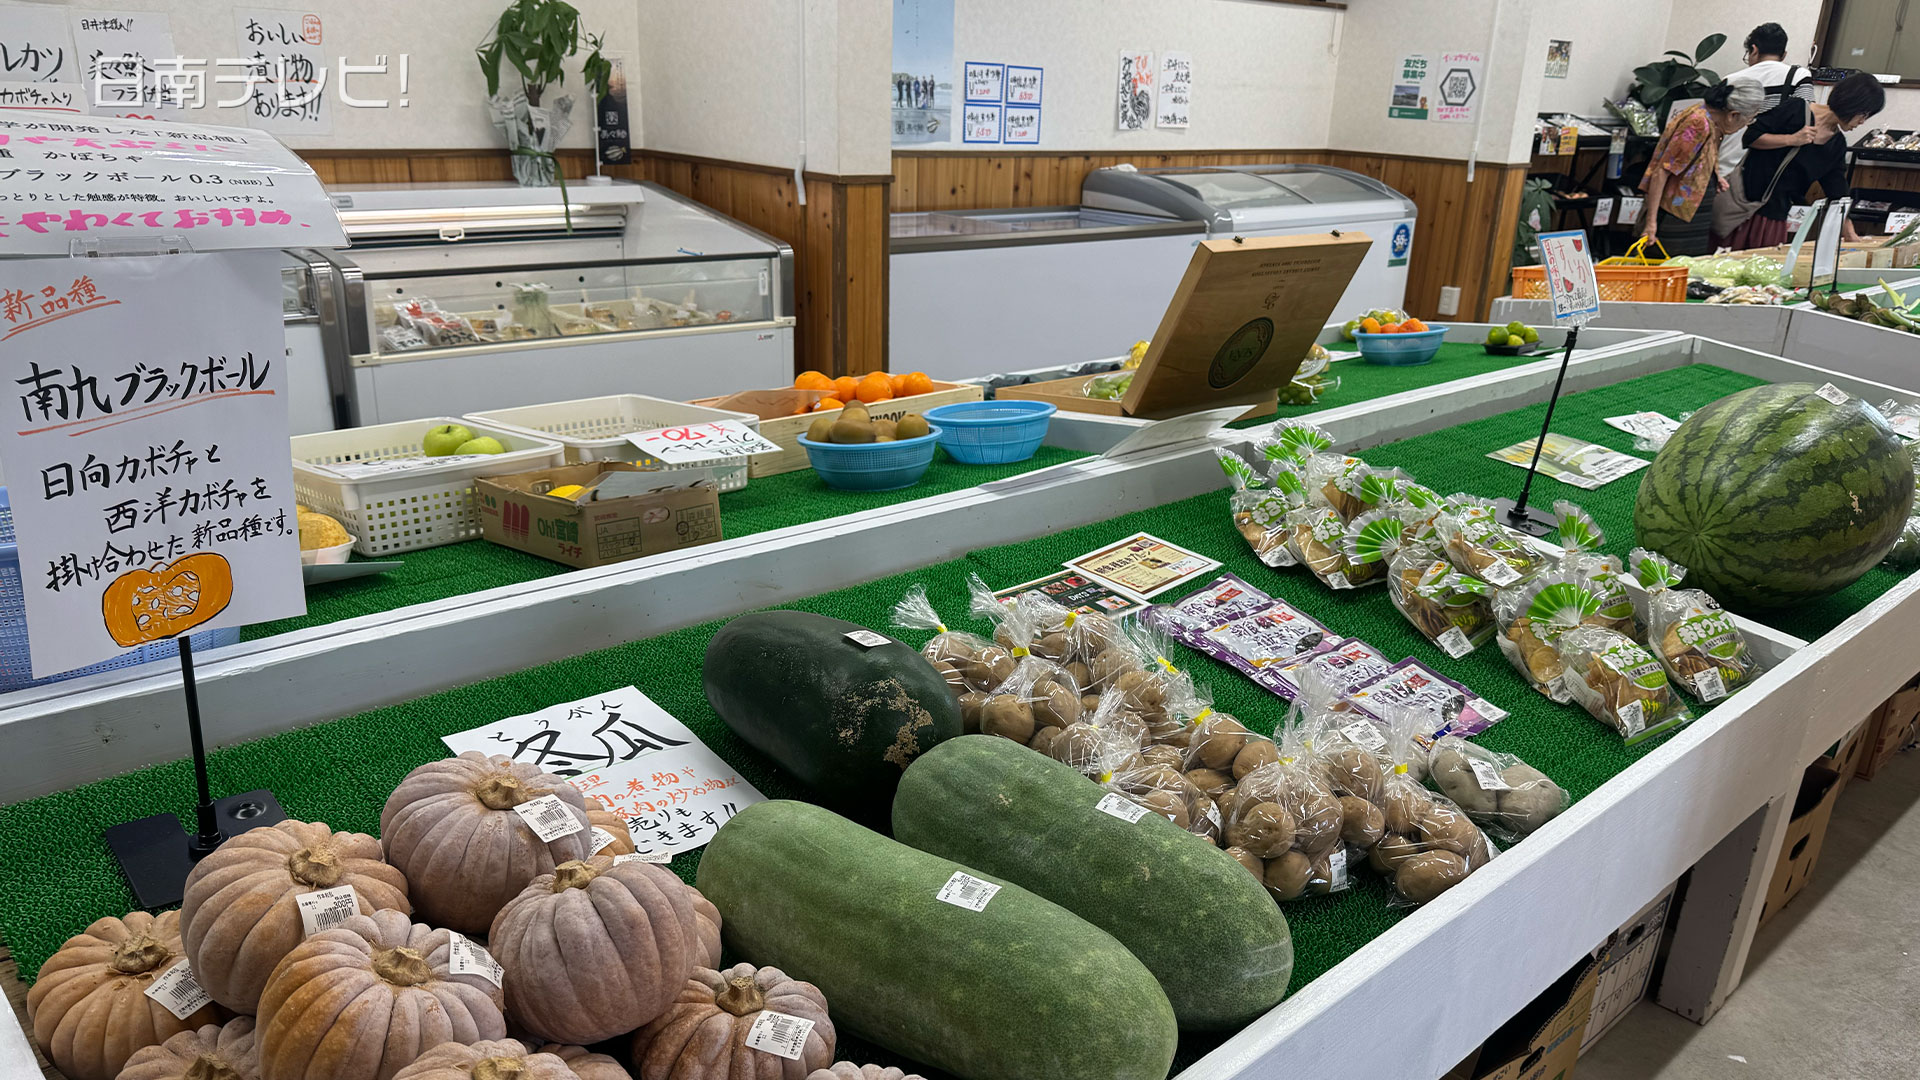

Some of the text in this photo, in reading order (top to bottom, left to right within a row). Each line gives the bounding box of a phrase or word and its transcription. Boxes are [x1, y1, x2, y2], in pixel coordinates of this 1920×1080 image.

[246, 18, 306, 46] おいしい
[189, 173, 223, 185] 0.3
[2, 275, 107, 323] 新品種
[15, 351, 270, 423] 南九ブラックボール
[41, 440, 221, 500] 日向カボチャと
[104, 477, 273, 534] 西洋カボチャを
[537, 517, 579, 545] Oh!宮崎
[557, 542, 583, 559] ライチ
[512, 712, 692, 776] 冬瓜
